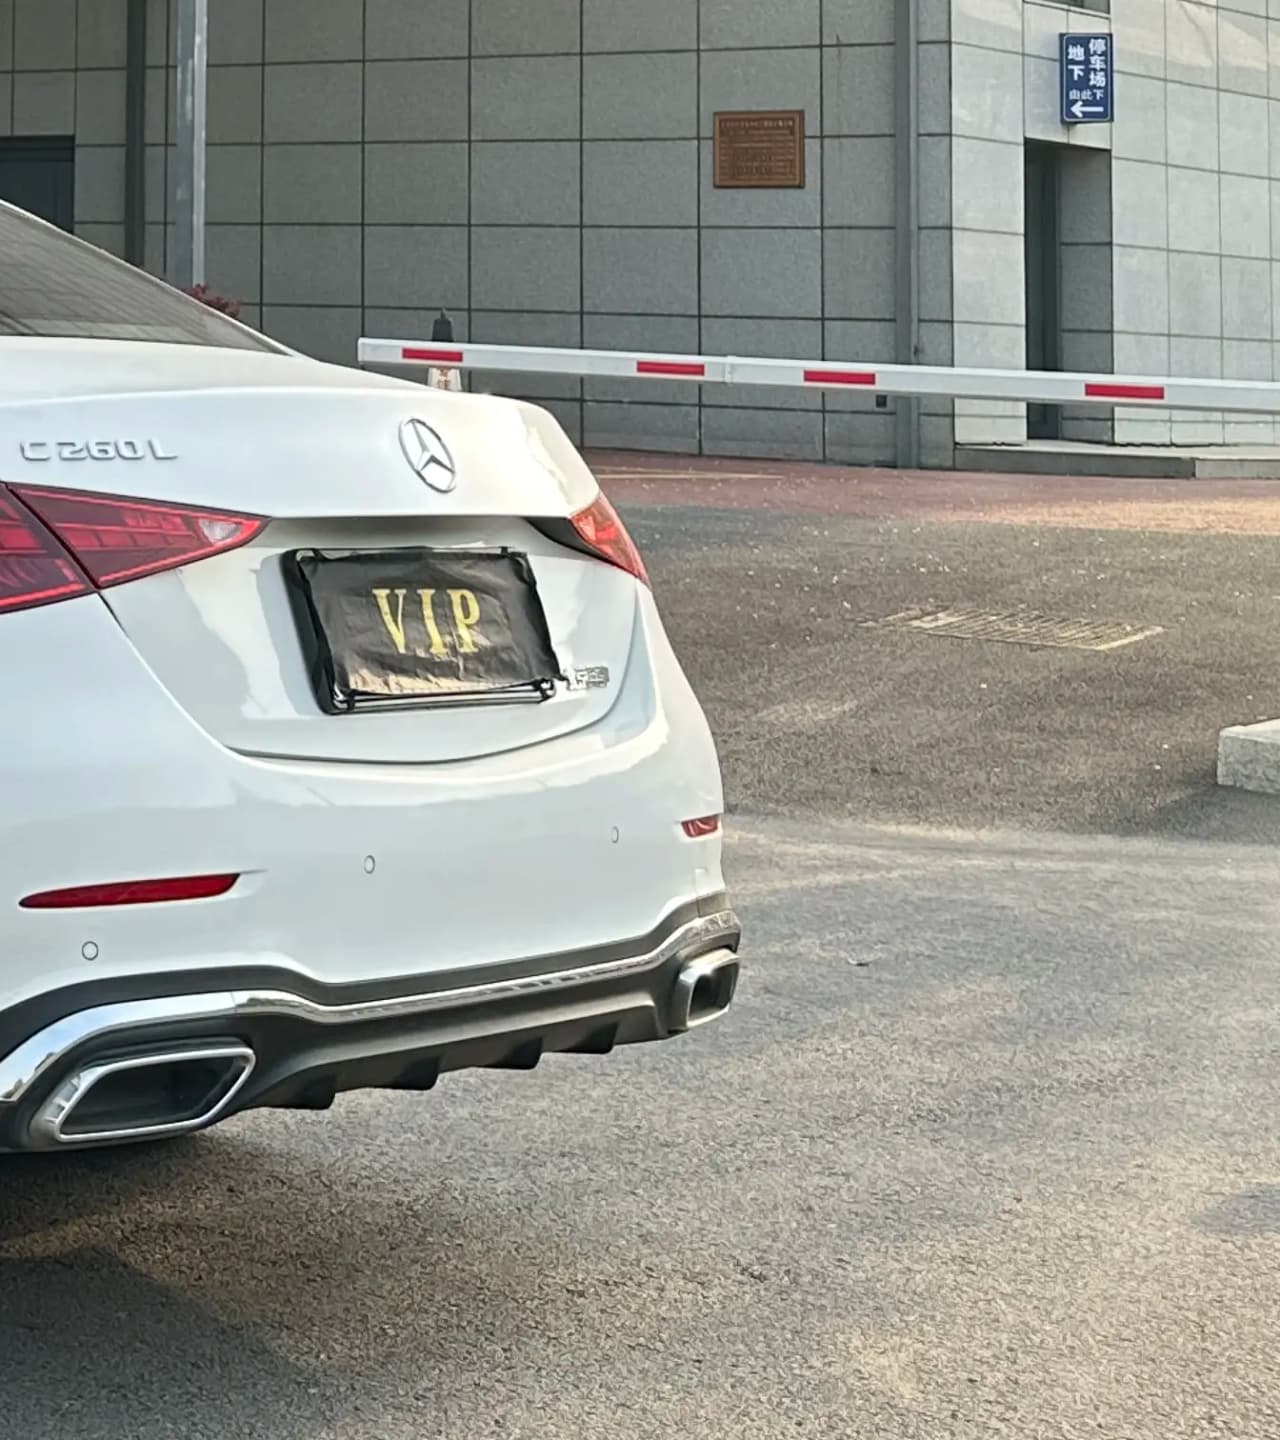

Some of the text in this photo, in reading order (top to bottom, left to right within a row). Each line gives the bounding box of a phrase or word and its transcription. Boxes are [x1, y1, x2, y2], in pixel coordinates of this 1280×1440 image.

[1068, 45, 1085, 80] 地下
[1088, 38, 1107, 88] 停车场
[372, 588, 481, 656] VIP
